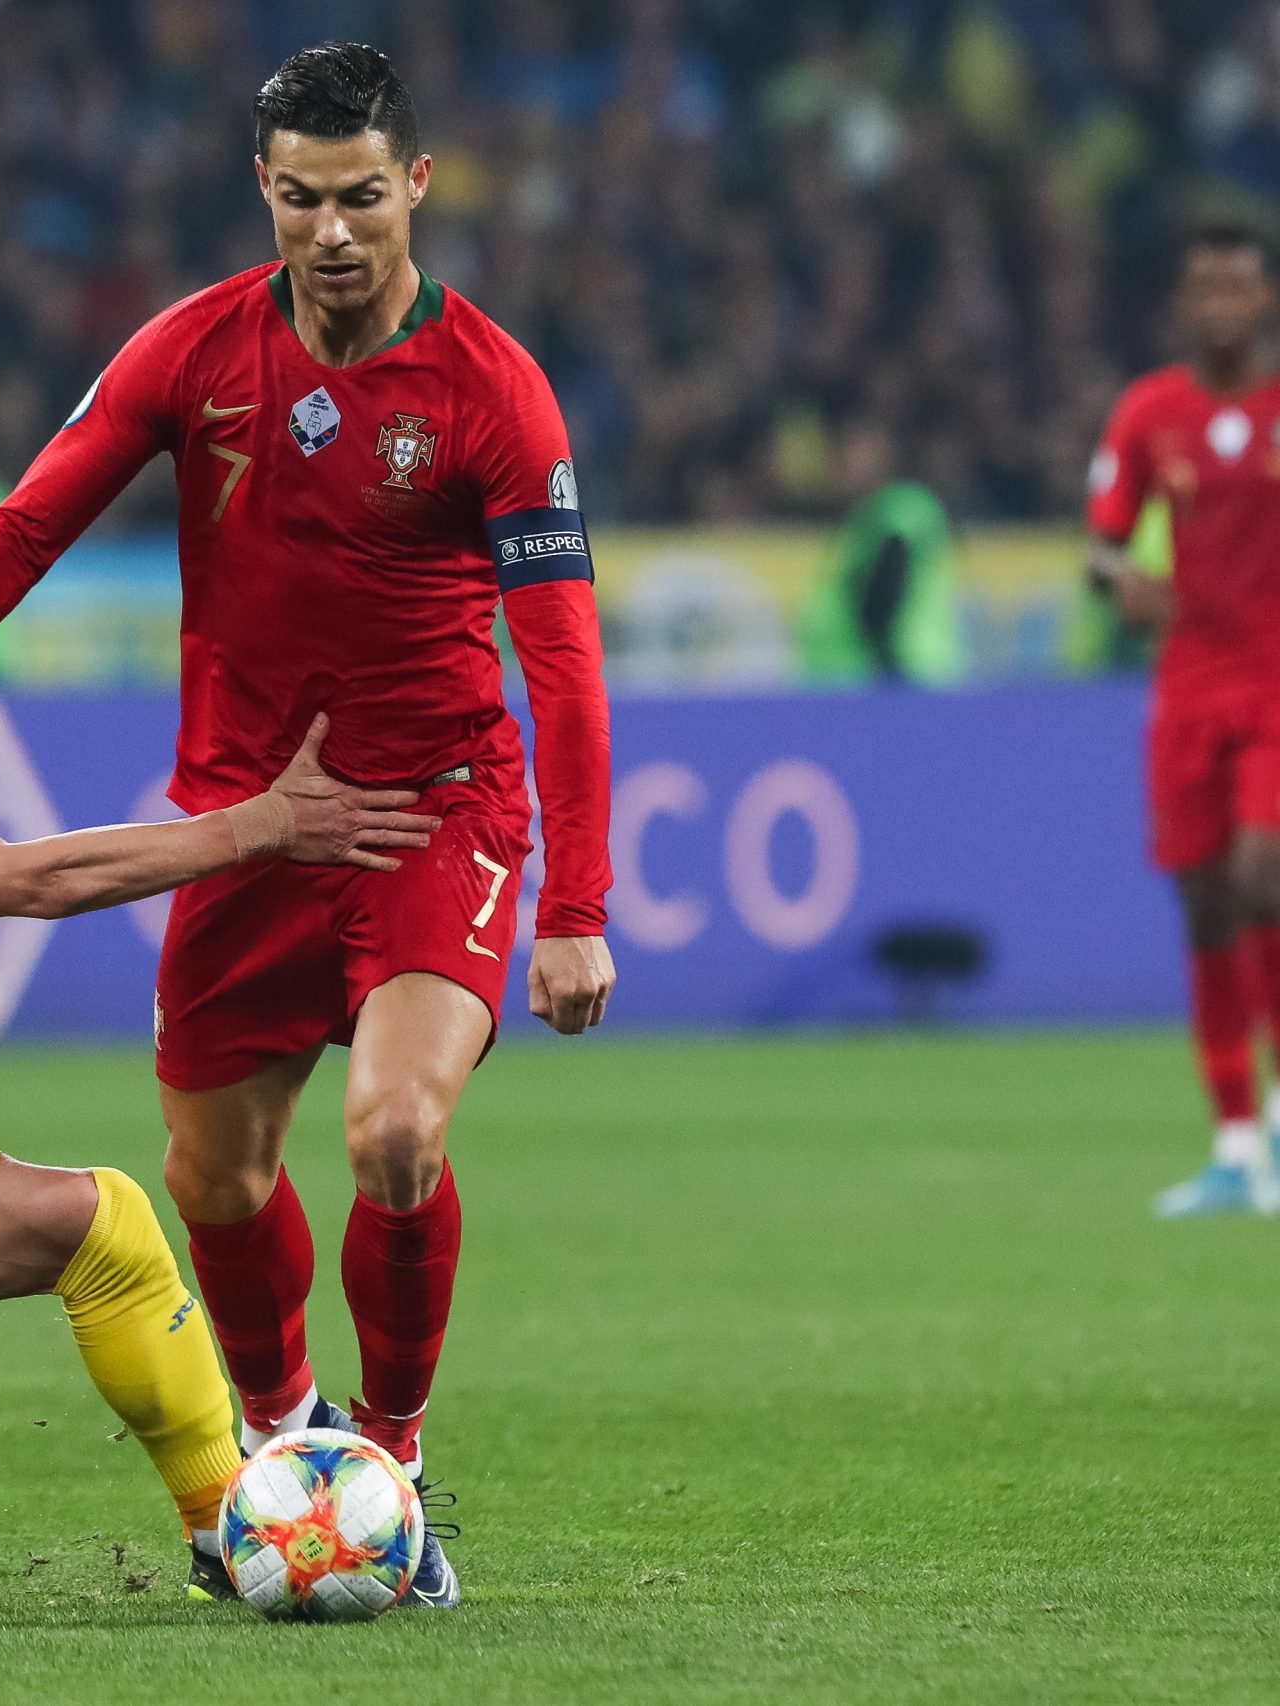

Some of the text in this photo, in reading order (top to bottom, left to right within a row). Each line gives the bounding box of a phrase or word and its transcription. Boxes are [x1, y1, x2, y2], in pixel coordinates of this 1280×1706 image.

[208, 442, 253, 522] 7
[524, 536, 585, 554] RESPECT
[472, 850, 510, 929] 7
